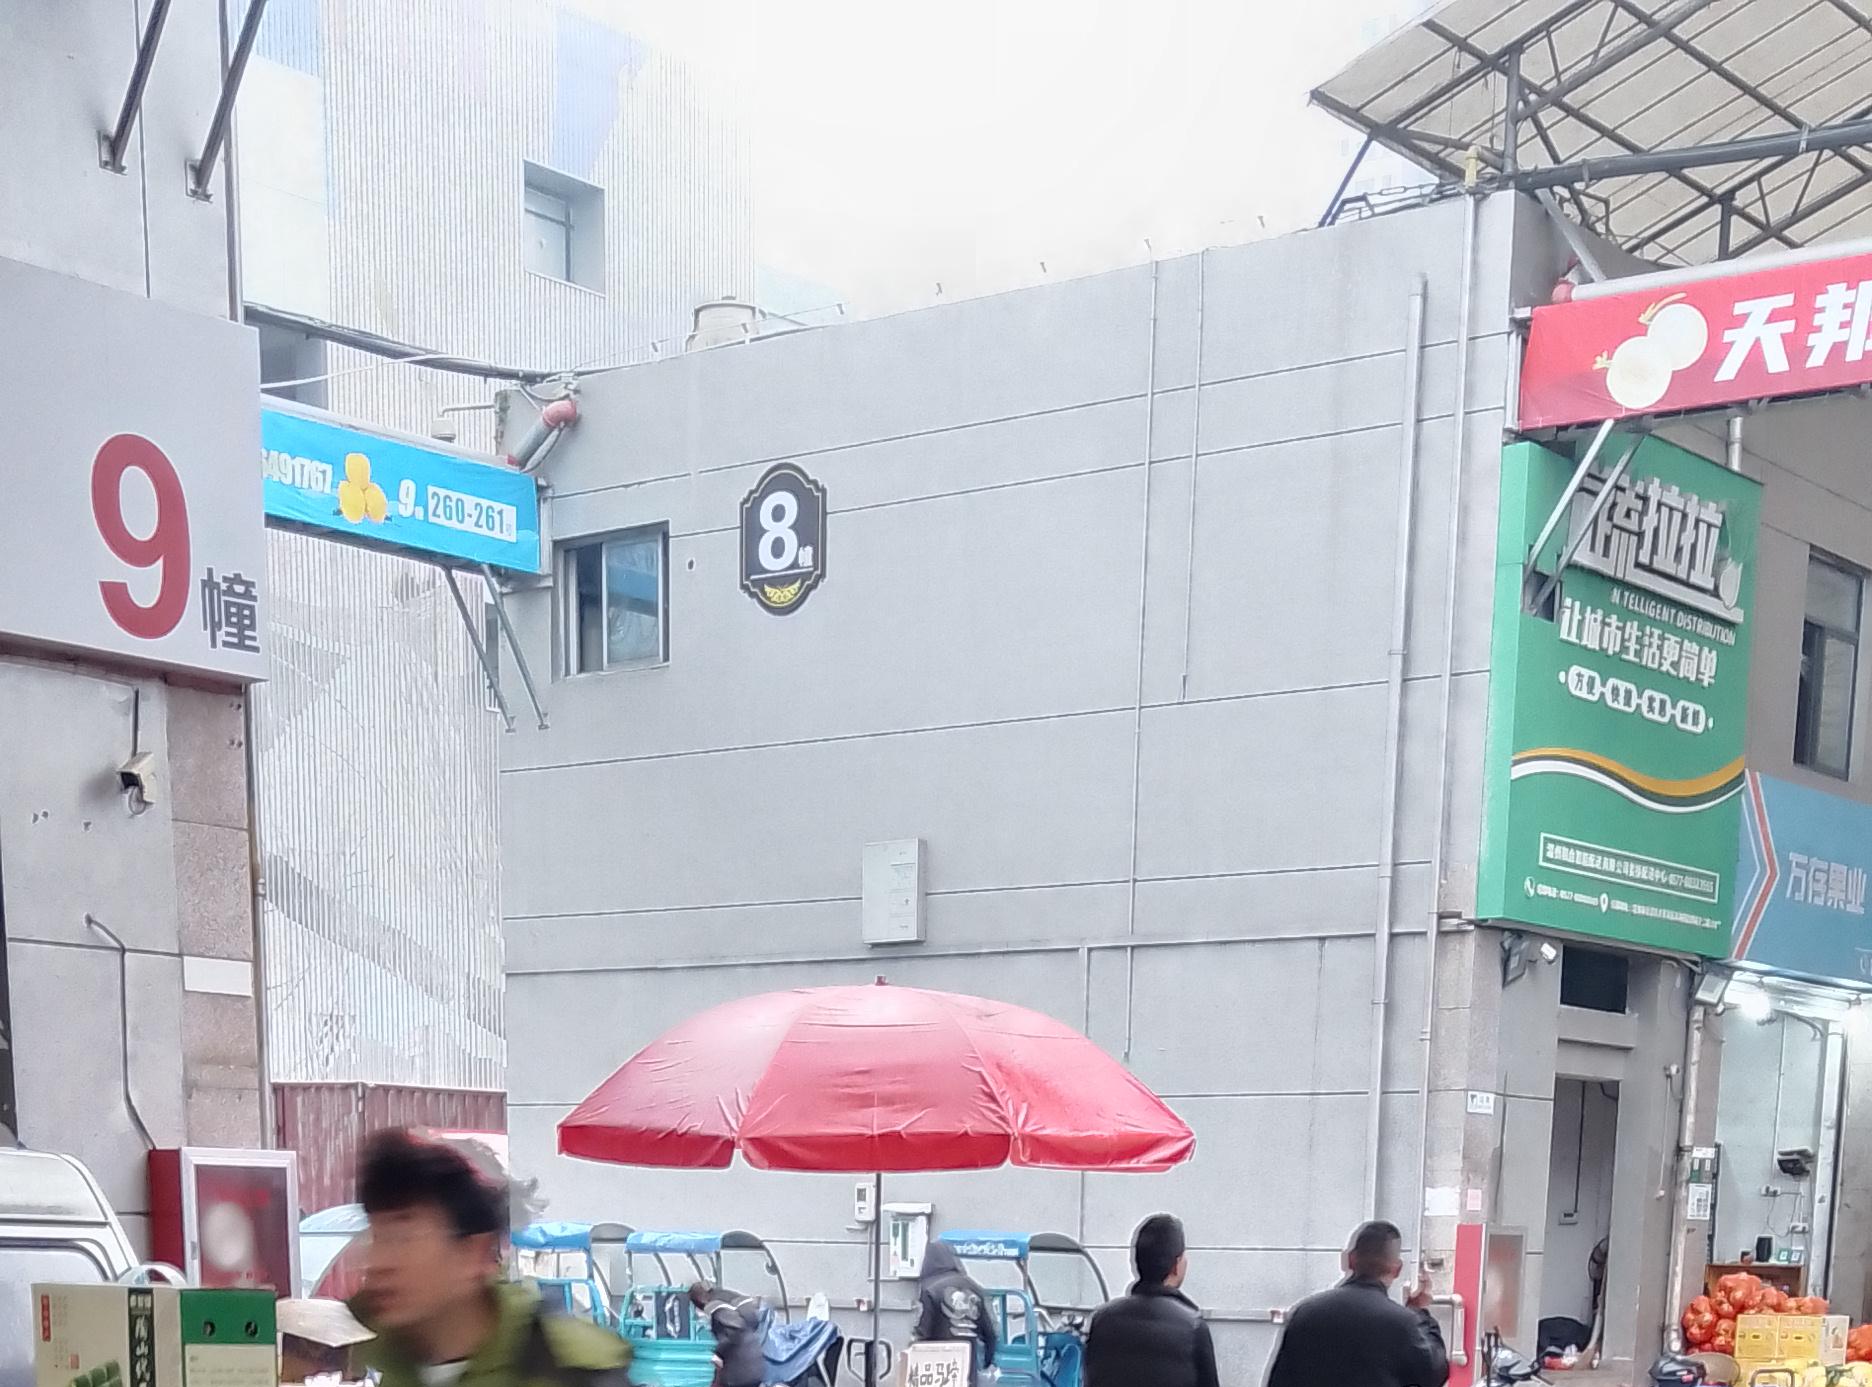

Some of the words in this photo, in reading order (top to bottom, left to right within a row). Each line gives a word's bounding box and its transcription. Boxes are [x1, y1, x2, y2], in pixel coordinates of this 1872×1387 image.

[1559, 598, 1718, 687] 让城市生活更简单
[1677, 610, 1736, 646] DISTRUTION
